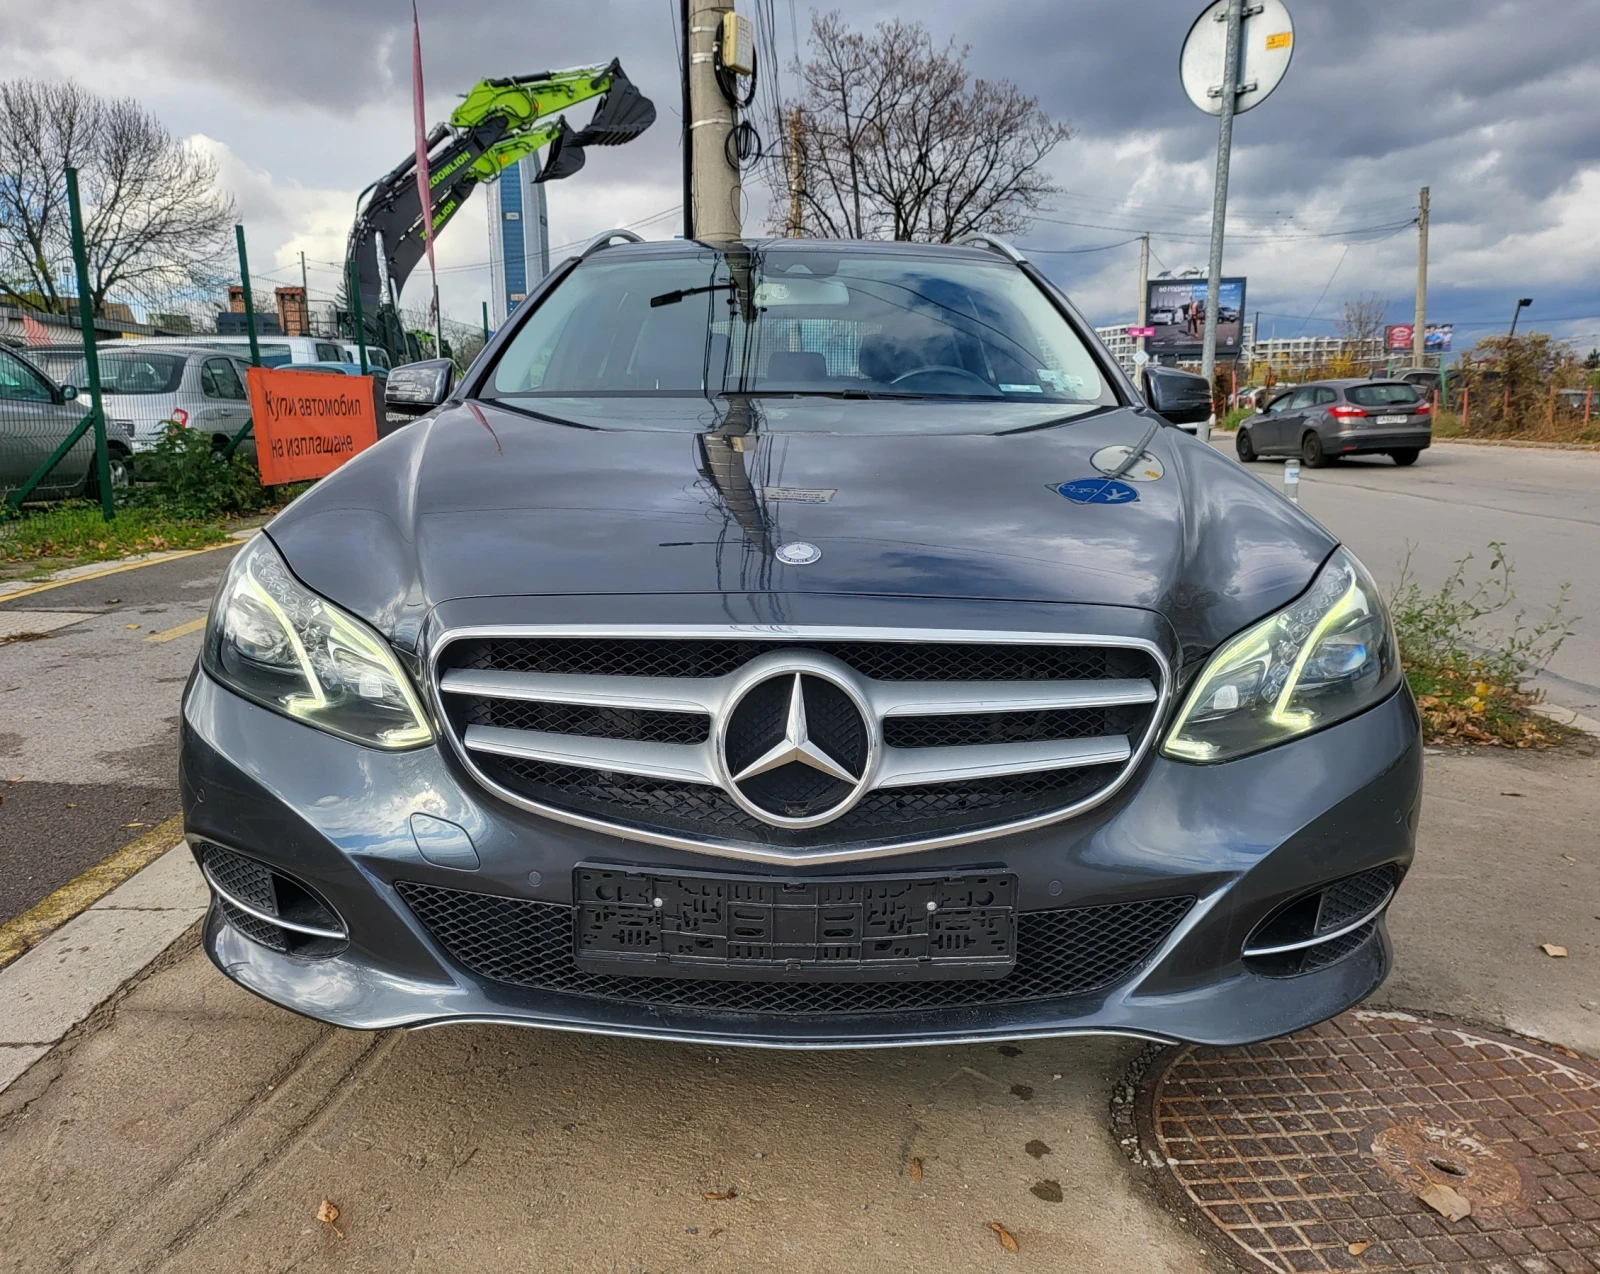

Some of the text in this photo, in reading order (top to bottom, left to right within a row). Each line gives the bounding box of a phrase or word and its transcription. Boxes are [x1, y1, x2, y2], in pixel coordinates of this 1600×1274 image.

[419, 199, 456, 241] ZMLION
[265, 390, 362, 422] Купи автомобил
[271, 435, 353, 458] на изплащане
